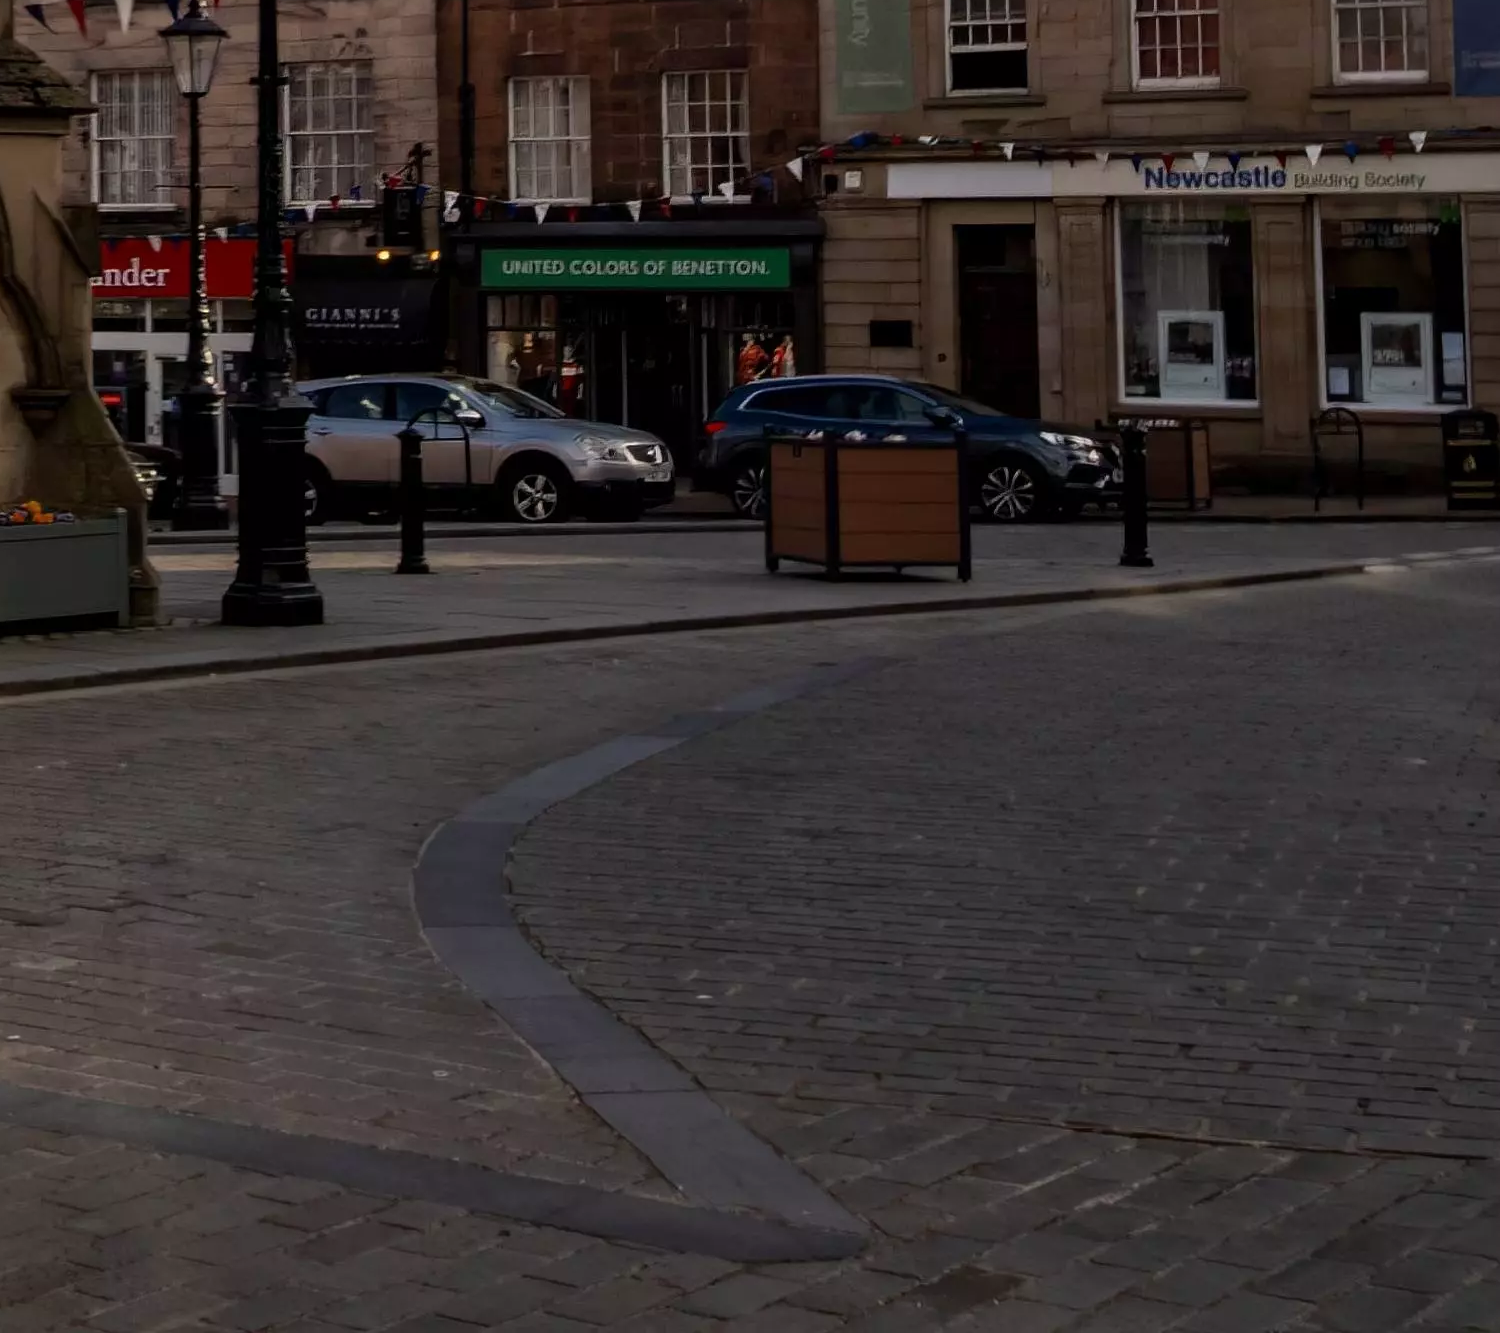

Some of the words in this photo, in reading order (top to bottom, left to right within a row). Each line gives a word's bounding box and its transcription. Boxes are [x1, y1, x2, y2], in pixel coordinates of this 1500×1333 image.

[1144, 166, 1286, 189] Newcastle
[1294, 173, 1359, 190] Building
[1364, 172, 1426, 190] Society
[502, 260, 565, 276] UNITED
[569, 260, 639, 276] COLORS
[643, 260, 665, 276] OF
[305, 307, 401, 322] GIANNI'S
